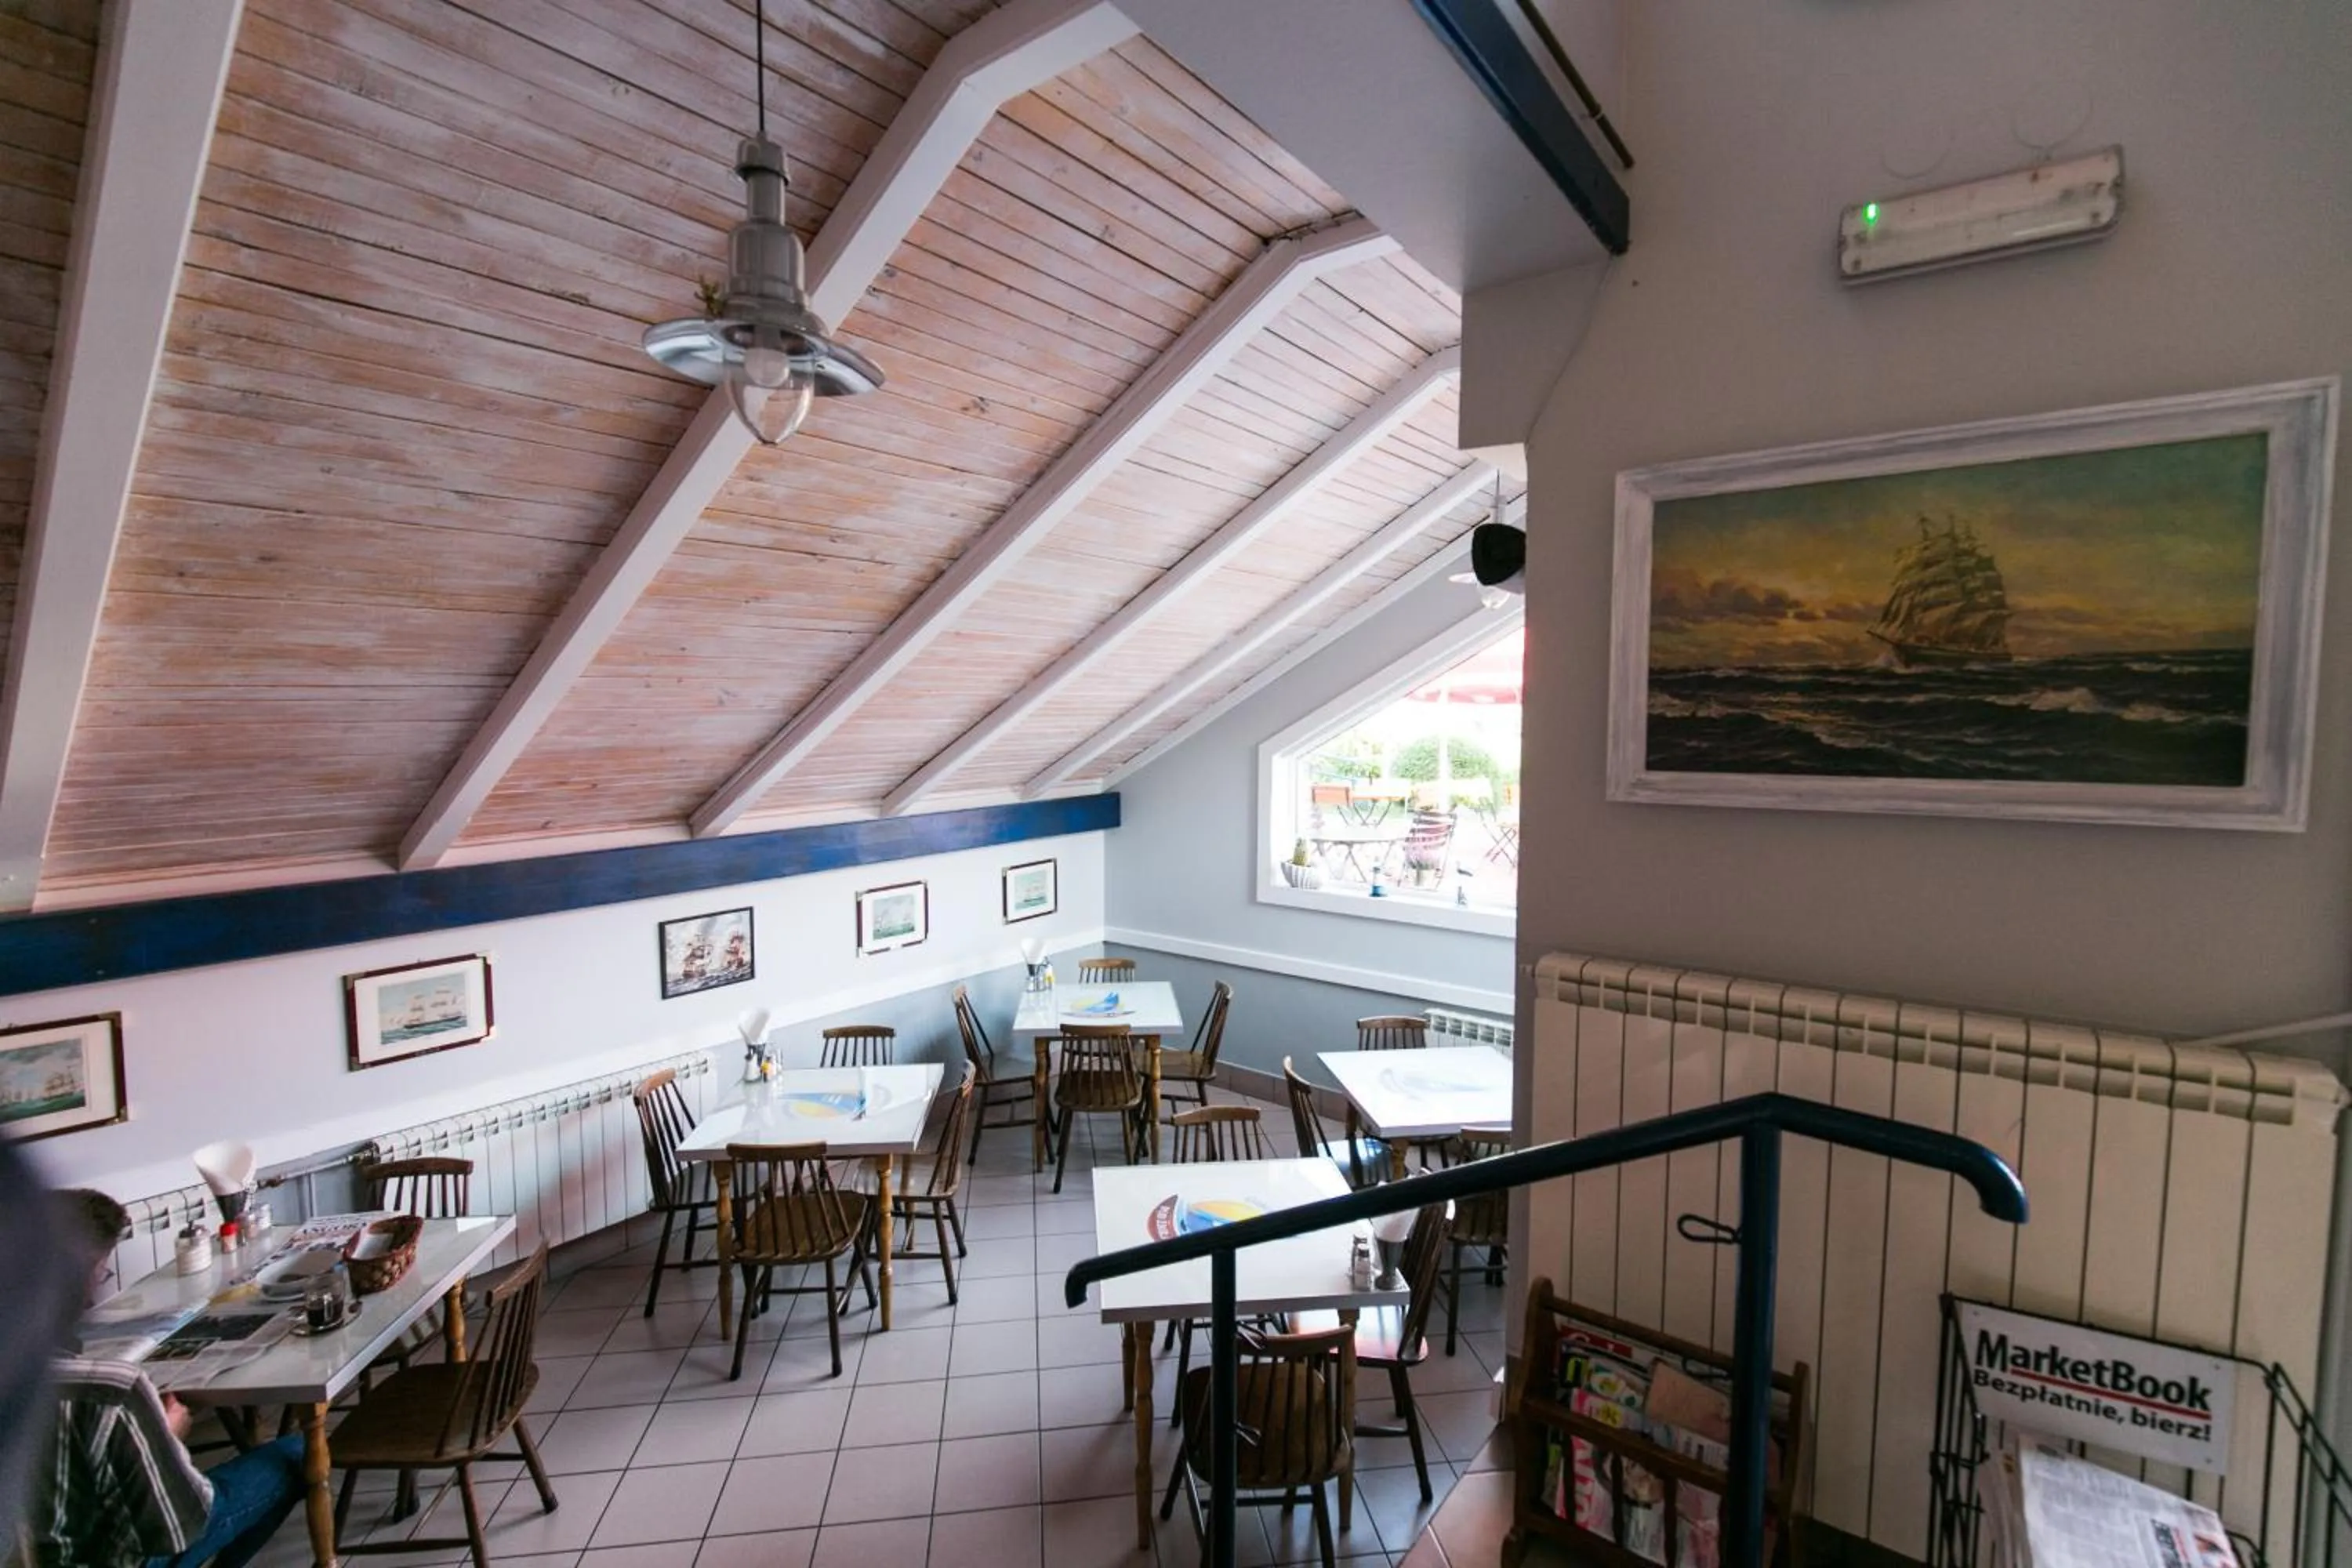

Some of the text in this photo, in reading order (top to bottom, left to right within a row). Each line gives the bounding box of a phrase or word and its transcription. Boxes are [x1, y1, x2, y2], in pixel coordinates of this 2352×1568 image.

[1973, 1369, 2212, 1441] Bezpłatnie, bierz!
[1975, 1329, 2212, 1410] MarketBook
